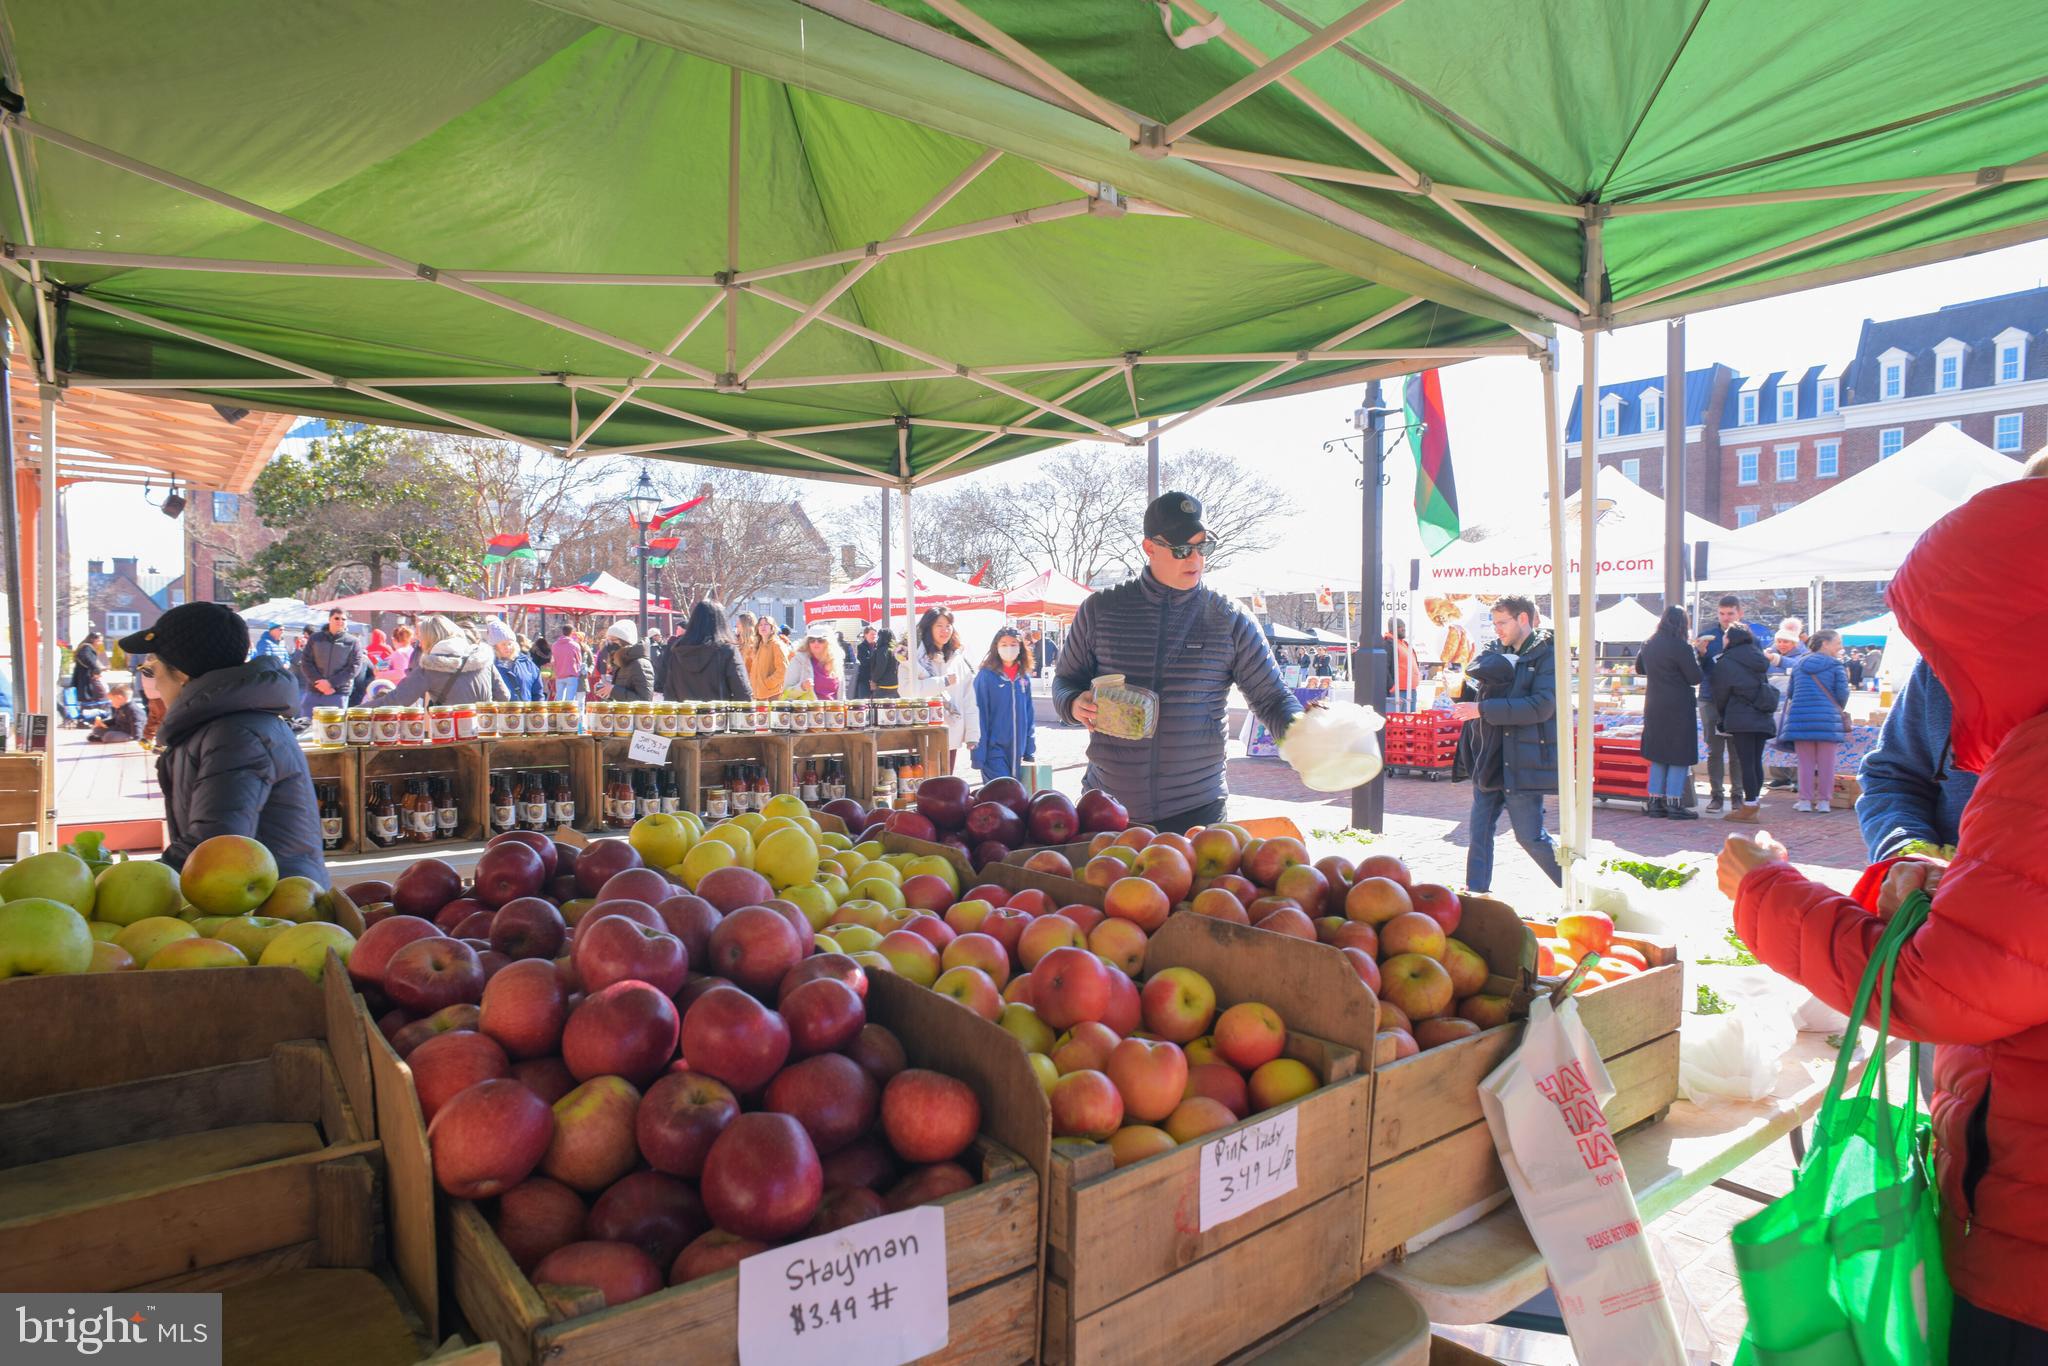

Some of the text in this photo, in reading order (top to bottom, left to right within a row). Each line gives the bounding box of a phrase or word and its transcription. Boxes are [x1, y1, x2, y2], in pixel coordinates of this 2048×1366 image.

[1432, 558, 1653, 579] www.mbbakeryoho.com
[1214, 1128, 1249, 1167] Pink
[1586, 1230, 1613, 1250] PLEASE
[785, 1234, 920, 1291] Stayman
[789, 1295, 857, 1336] $3.49
